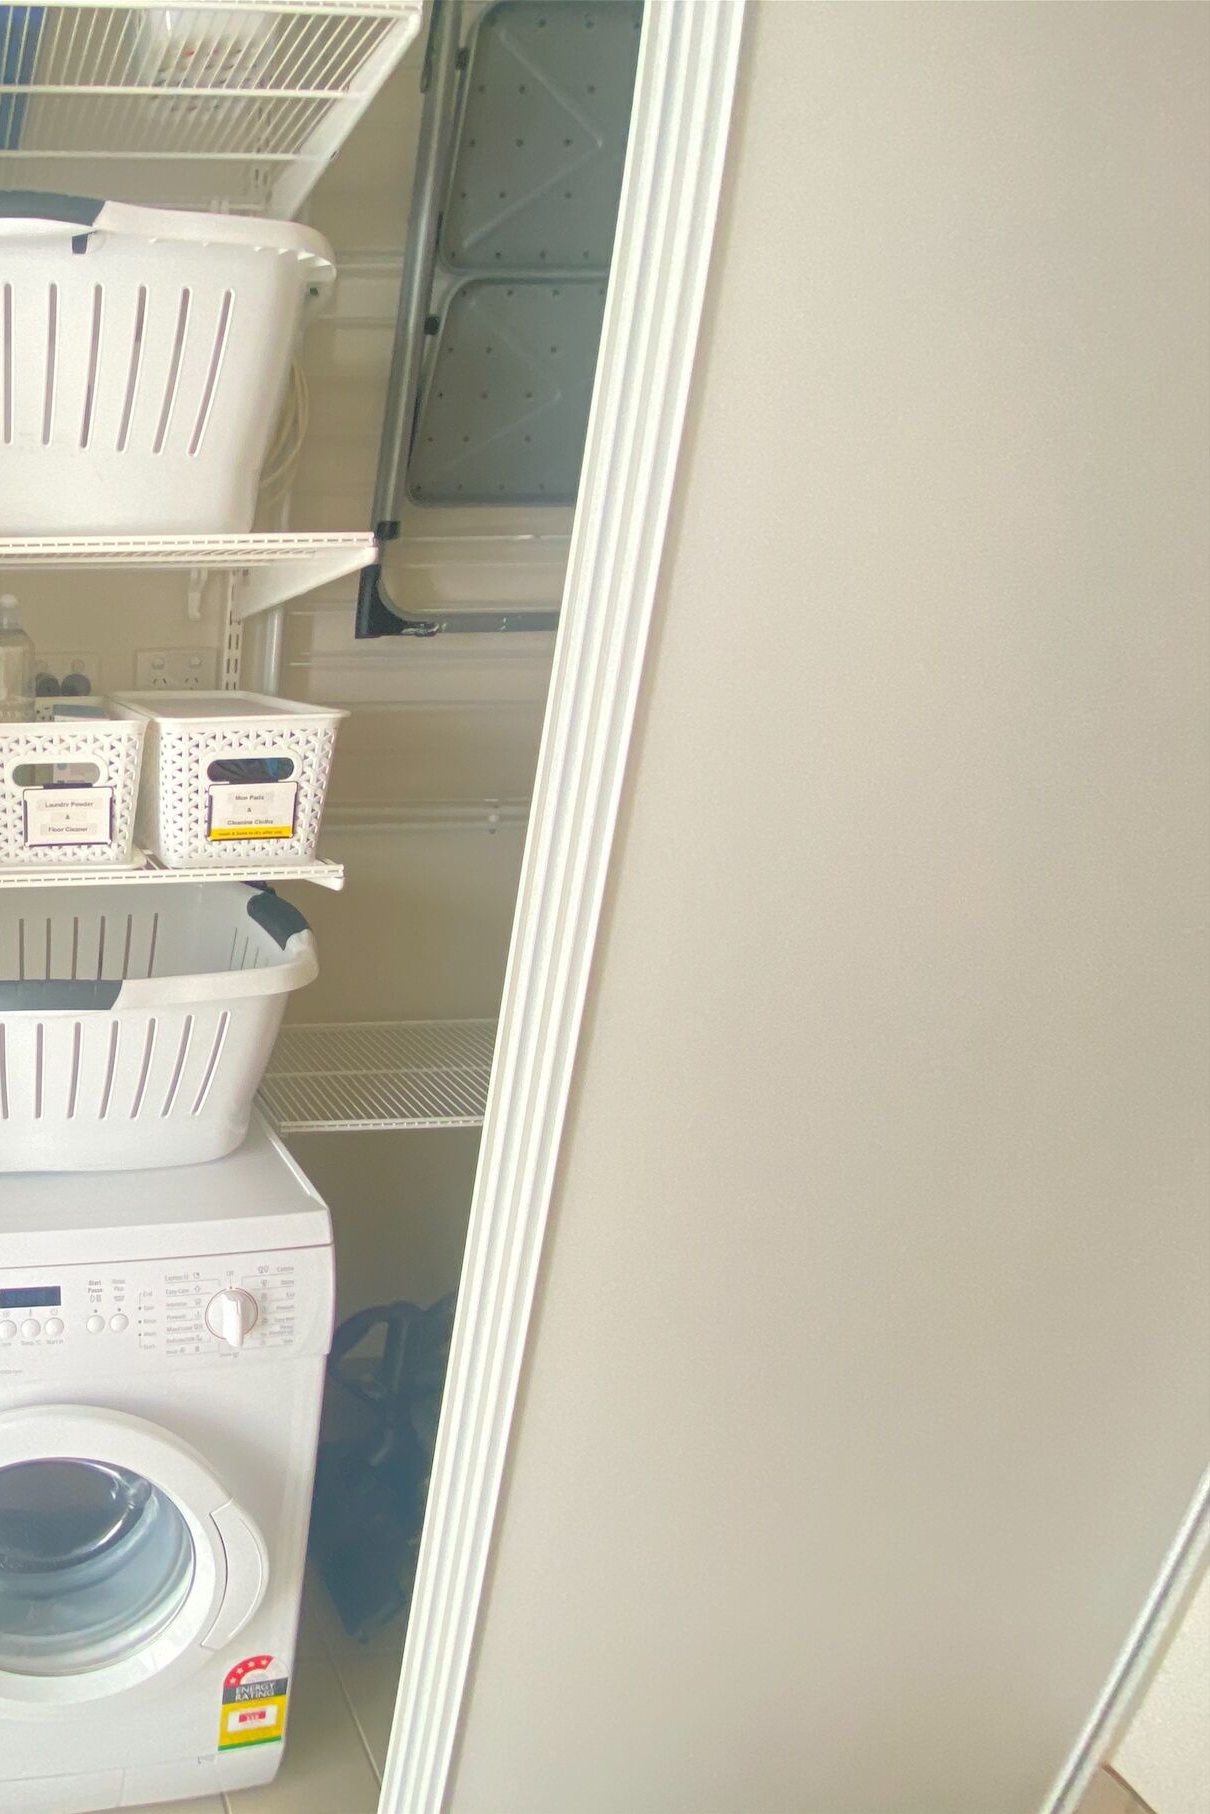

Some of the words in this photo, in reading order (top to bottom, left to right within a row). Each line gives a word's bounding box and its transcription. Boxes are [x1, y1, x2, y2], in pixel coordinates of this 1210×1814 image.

[45, 801, 69, 809] Laundry
[236, 1682, 276, 1694] ENERGY
[235, 1690, 275, 1701] RATING
